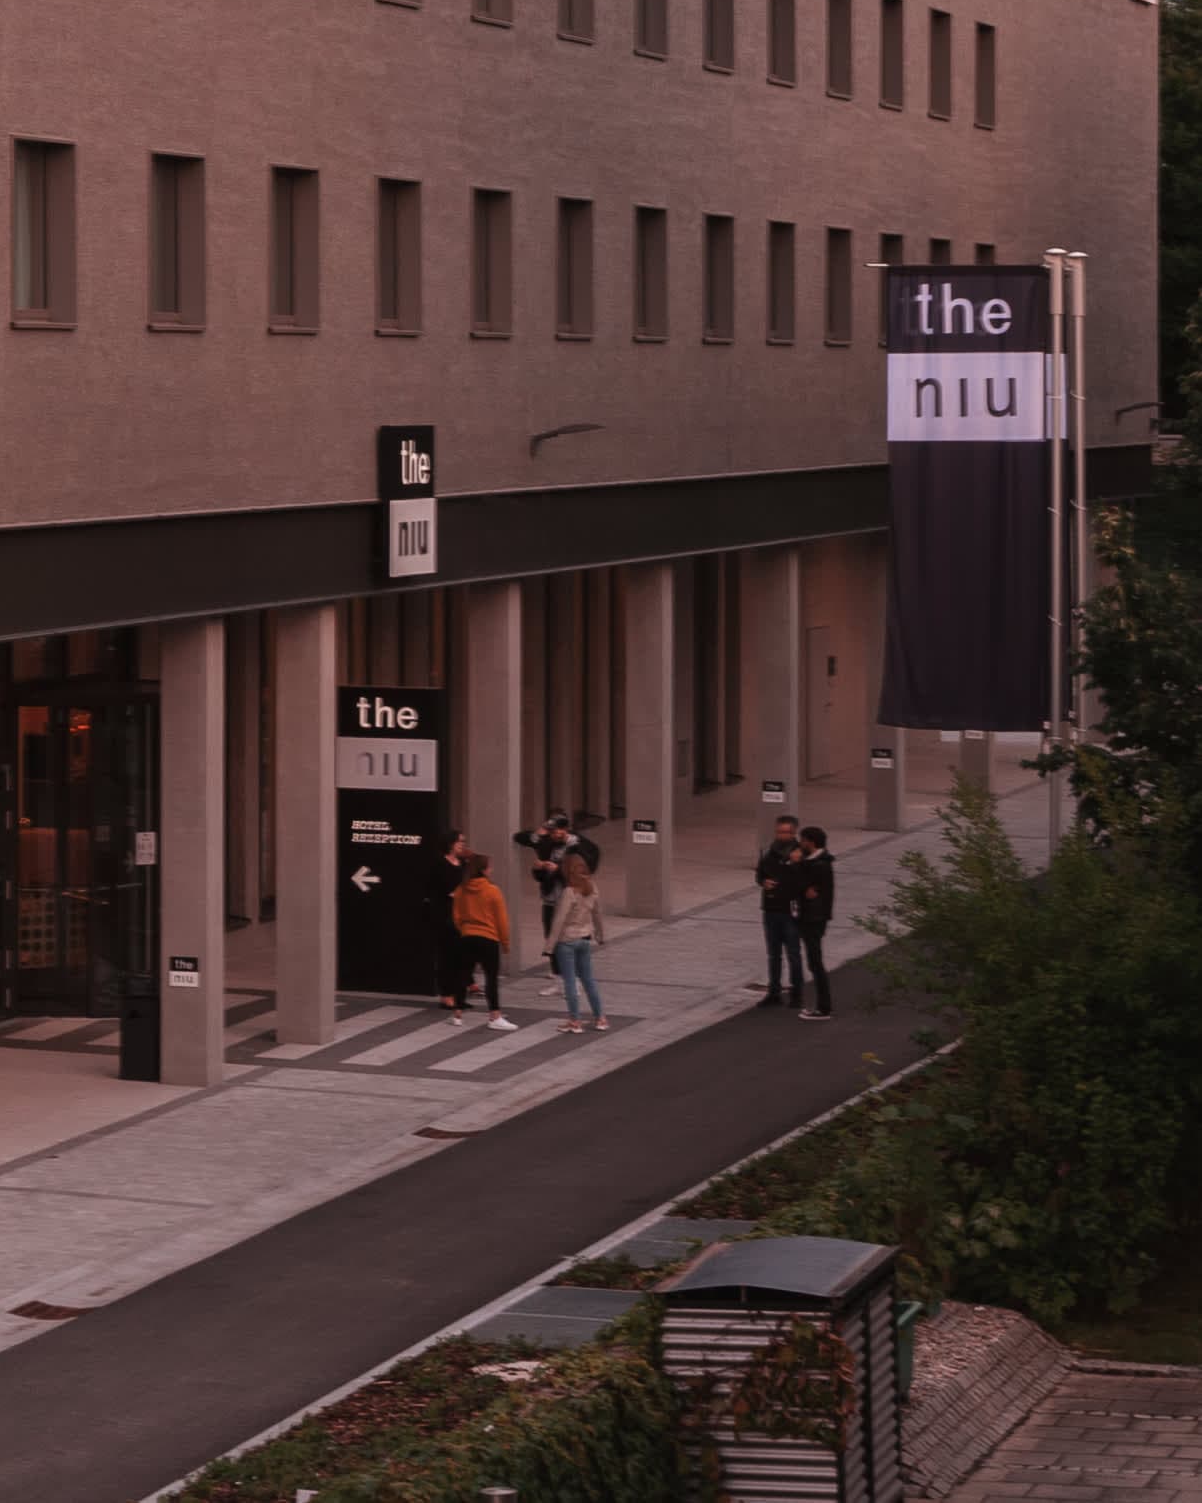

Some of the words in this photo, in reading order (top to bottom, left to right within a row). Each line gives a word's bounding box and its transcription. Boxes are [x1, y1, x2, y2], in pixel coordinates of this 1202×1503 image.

[914, 283, 1013, 335] the
[400, 439, 431, 486] the
[356, 696, 419, 730] the
